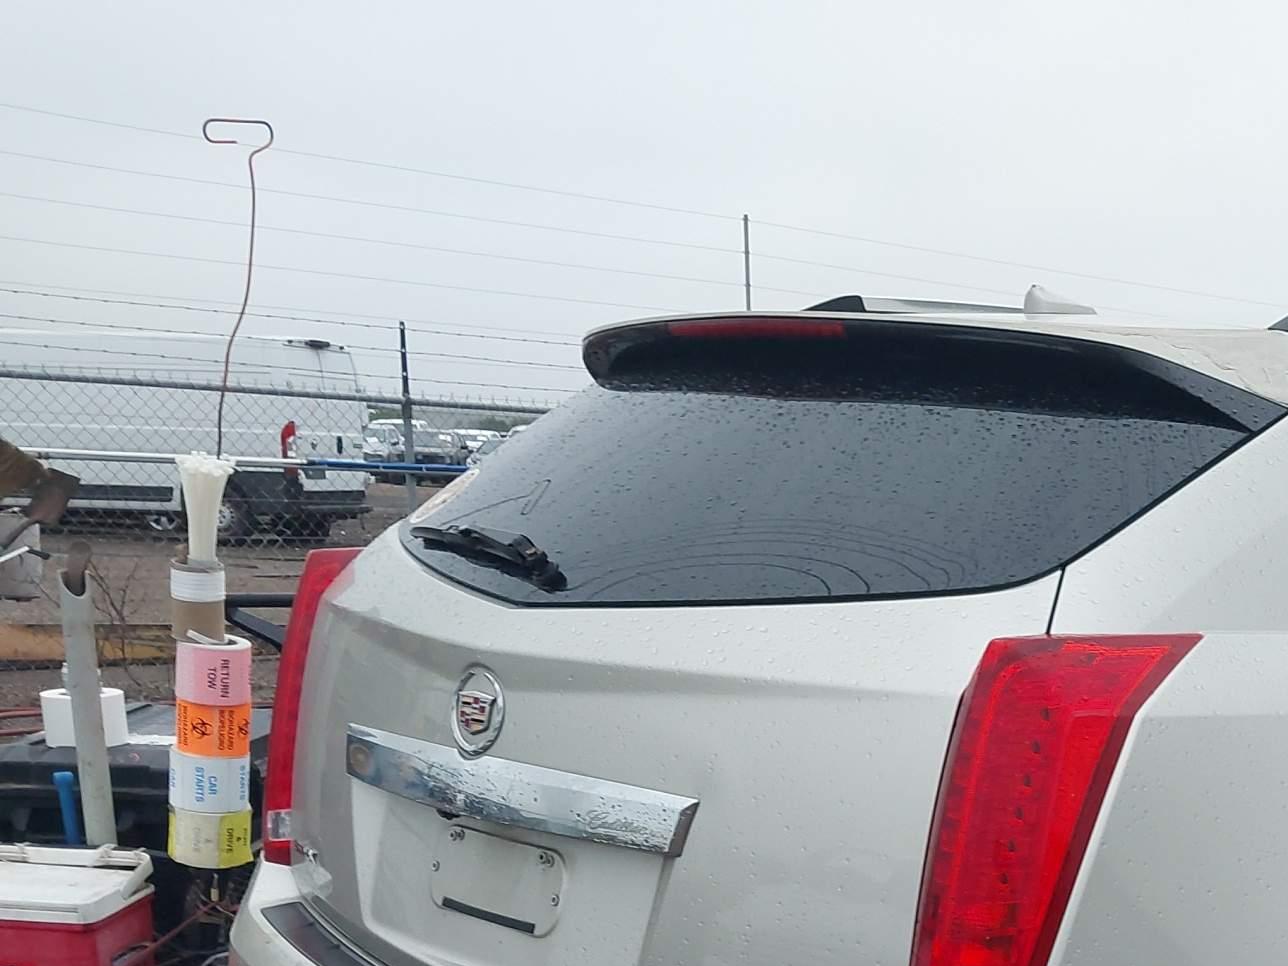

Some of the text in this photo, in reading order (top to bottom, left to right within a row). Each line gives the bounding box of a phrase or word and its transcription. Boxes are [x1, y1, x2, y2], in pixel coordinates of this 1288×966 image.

[208, 667, 217, 689] TOW
[220, 659, 230, 698] RETURN
[194, 767, 205, 803] STARTS
[208, 776, 217, 795] CAR
[225, 828, 234, 854] DRIVE
